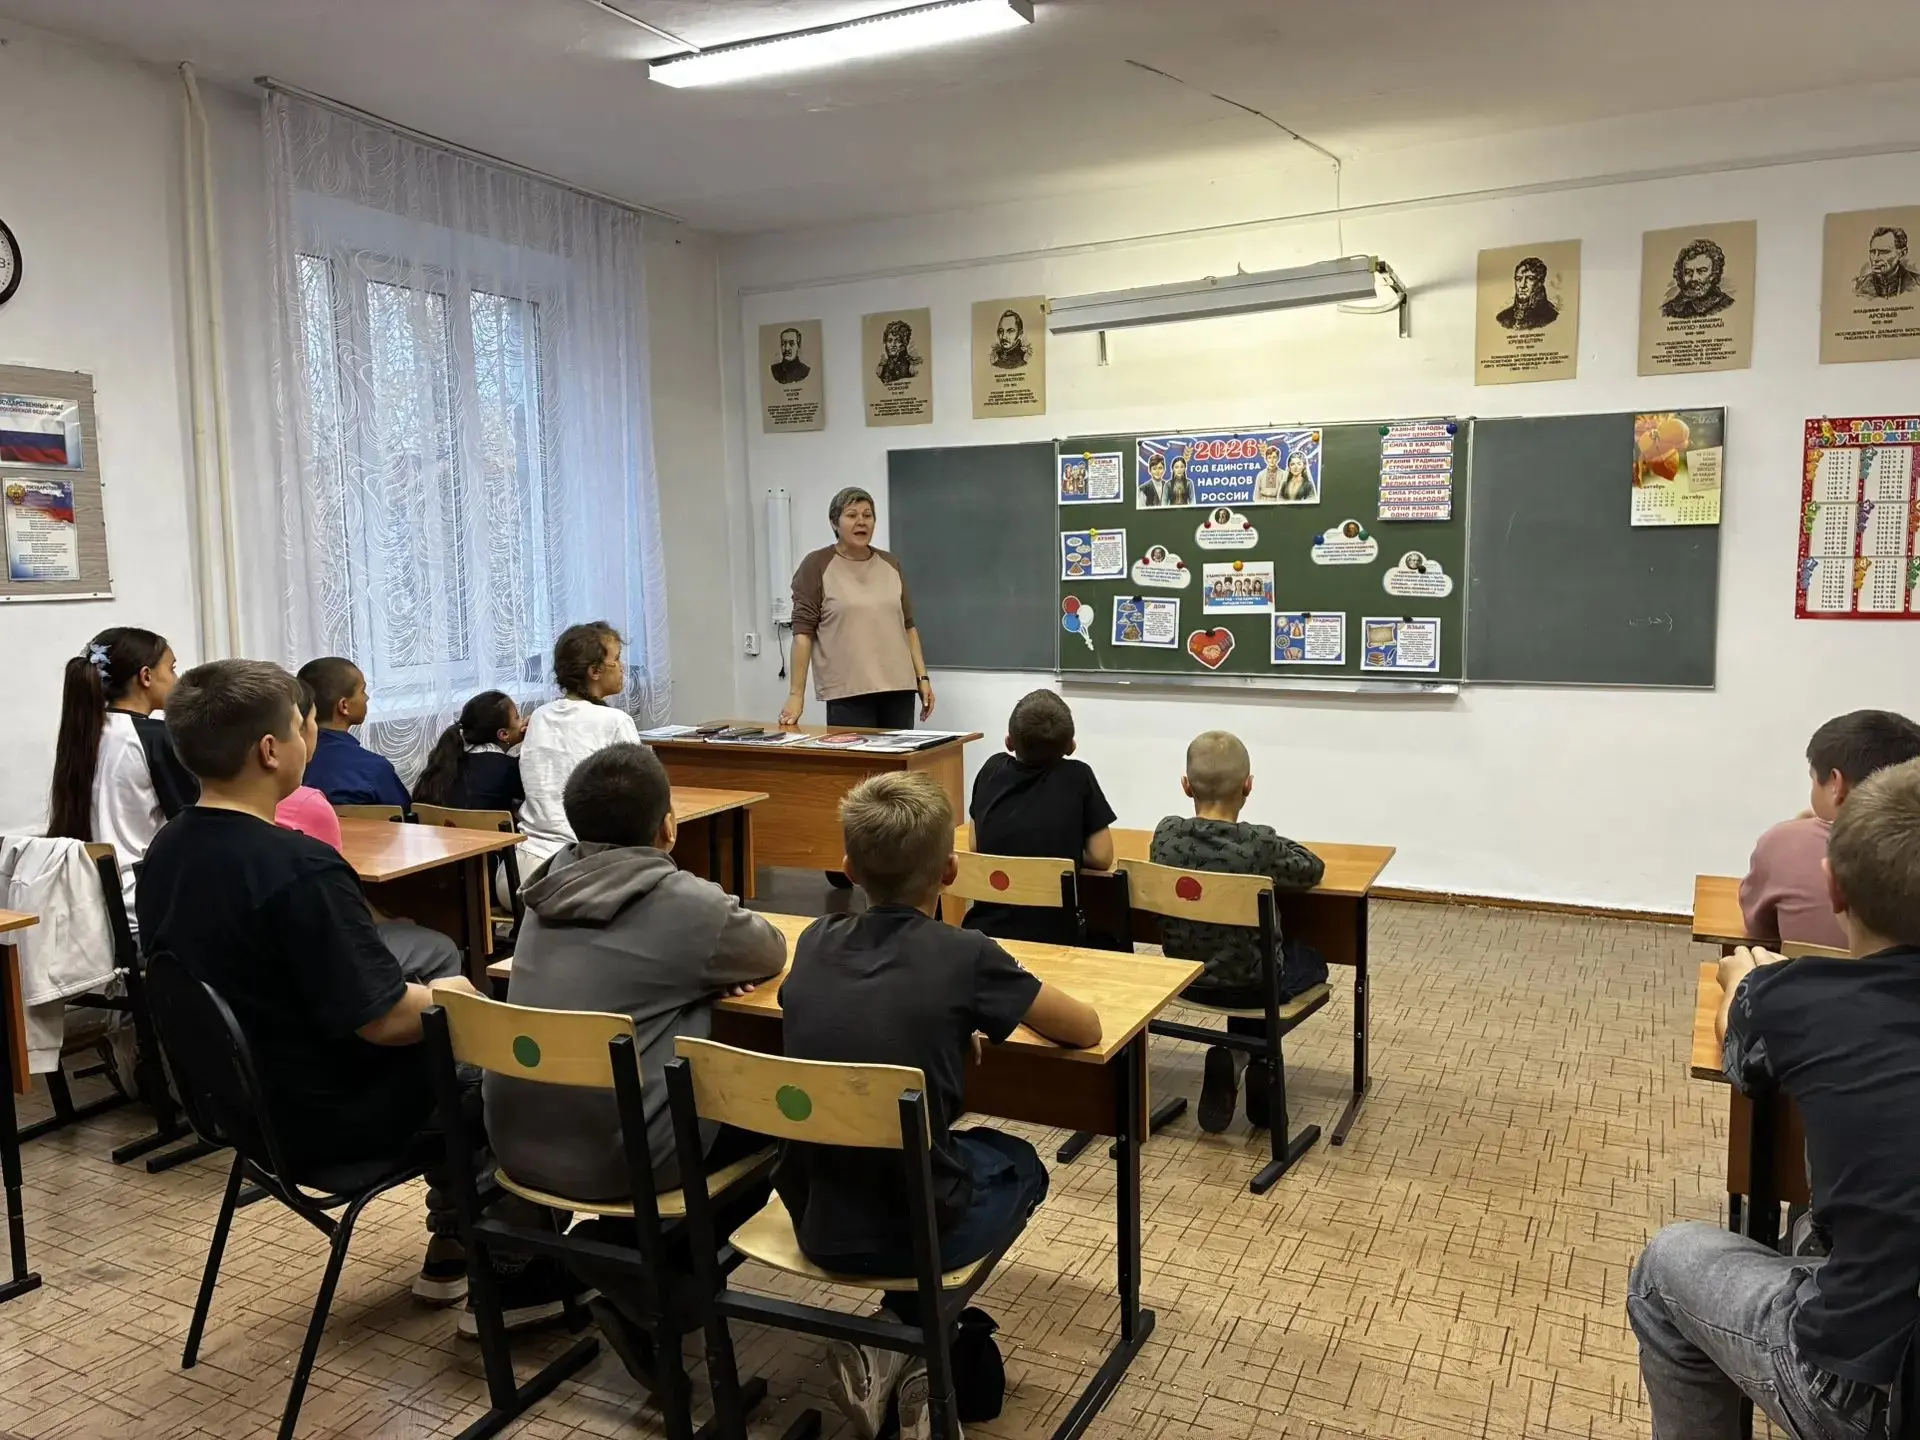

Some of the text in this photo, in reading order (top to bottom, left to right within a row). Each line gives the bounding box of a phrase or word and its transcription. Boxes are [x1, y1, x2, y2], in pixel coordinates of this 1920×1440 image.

[1850, 419, 1920, 432] ТАБЛИЦ
[1194, 440, 1258, 460] 2026
[1190, 463, 1260, 473] ГОД ЕДИНСТВА
[1198, 476, 1252, 487] НАРОДОВ
[1201, 492, 1249, 502] РОССИИ
